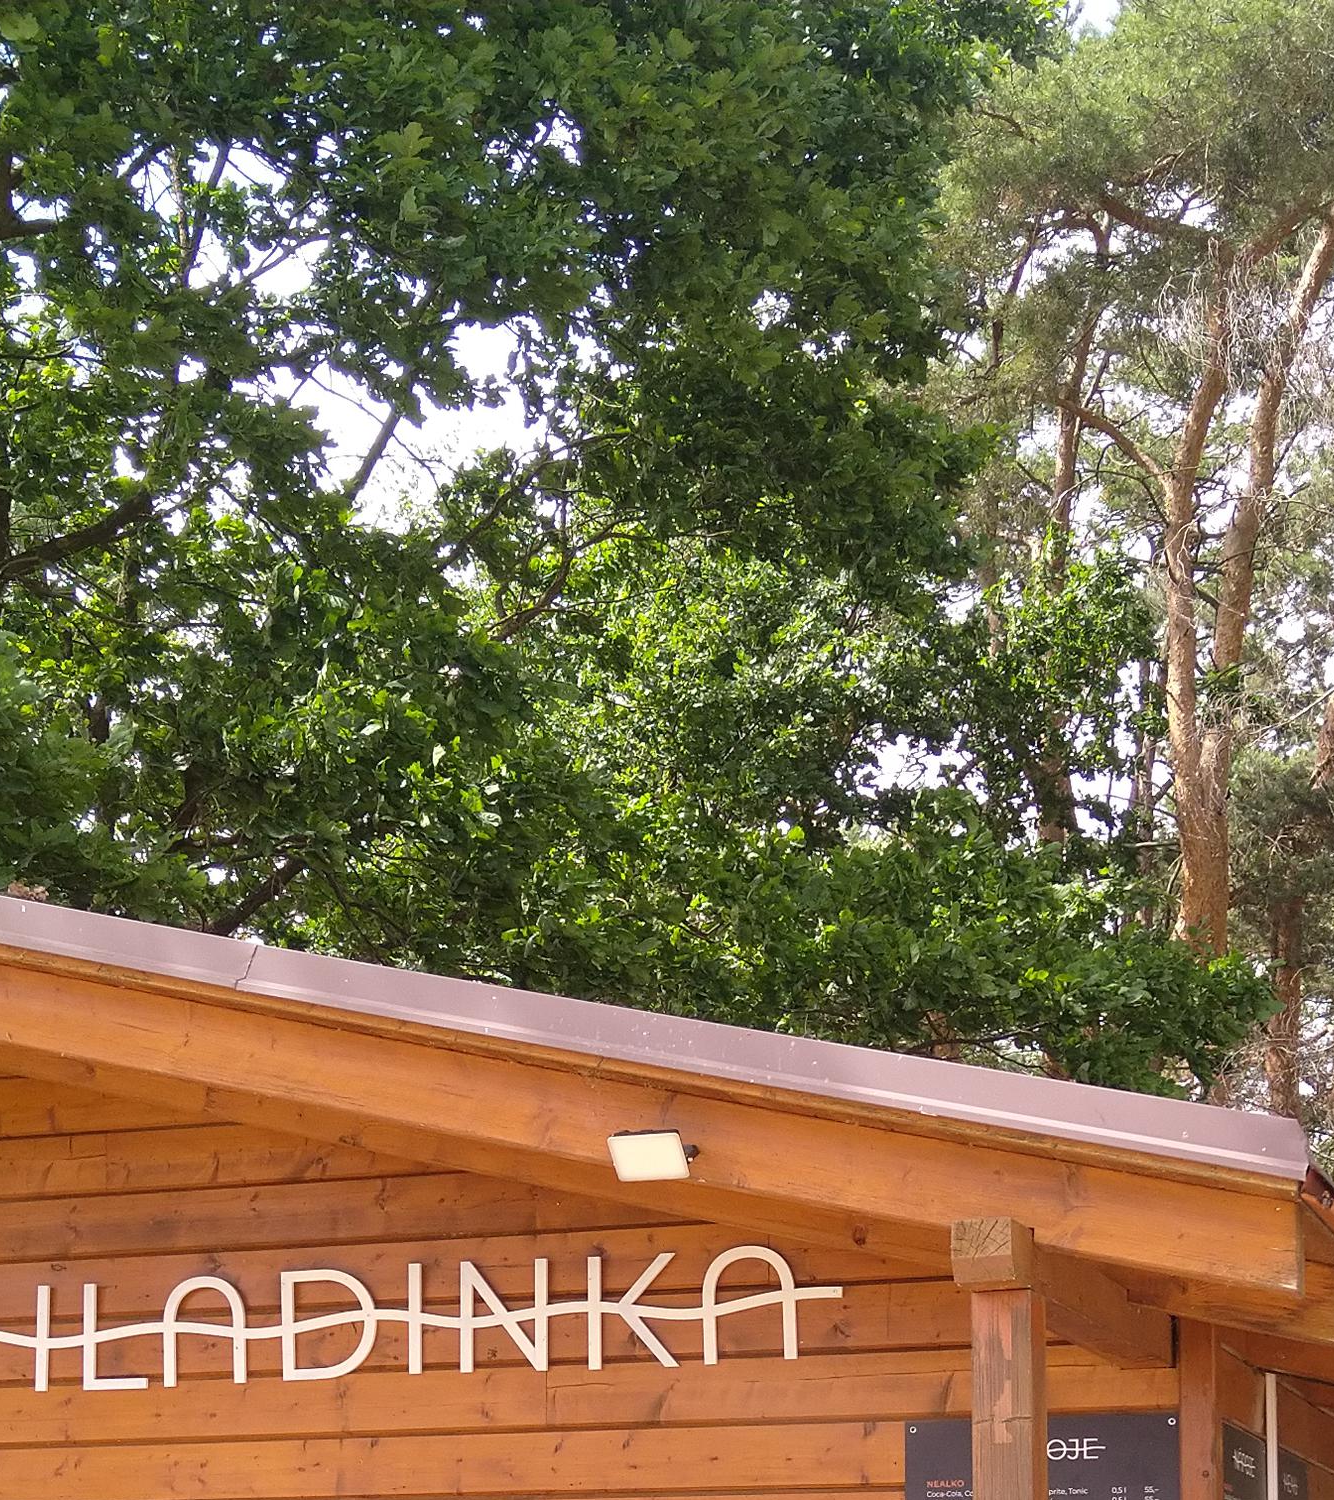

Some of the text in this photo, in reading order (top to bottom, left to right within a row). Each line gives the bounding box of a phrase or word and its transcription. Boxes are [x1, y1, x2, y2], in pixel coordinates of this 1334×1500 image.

[1047, 1439, 1106, 1460] OJE
[926, 1479, 964, 1488] NEALKO
[1049, 1488, 1068, 1496] prite,
